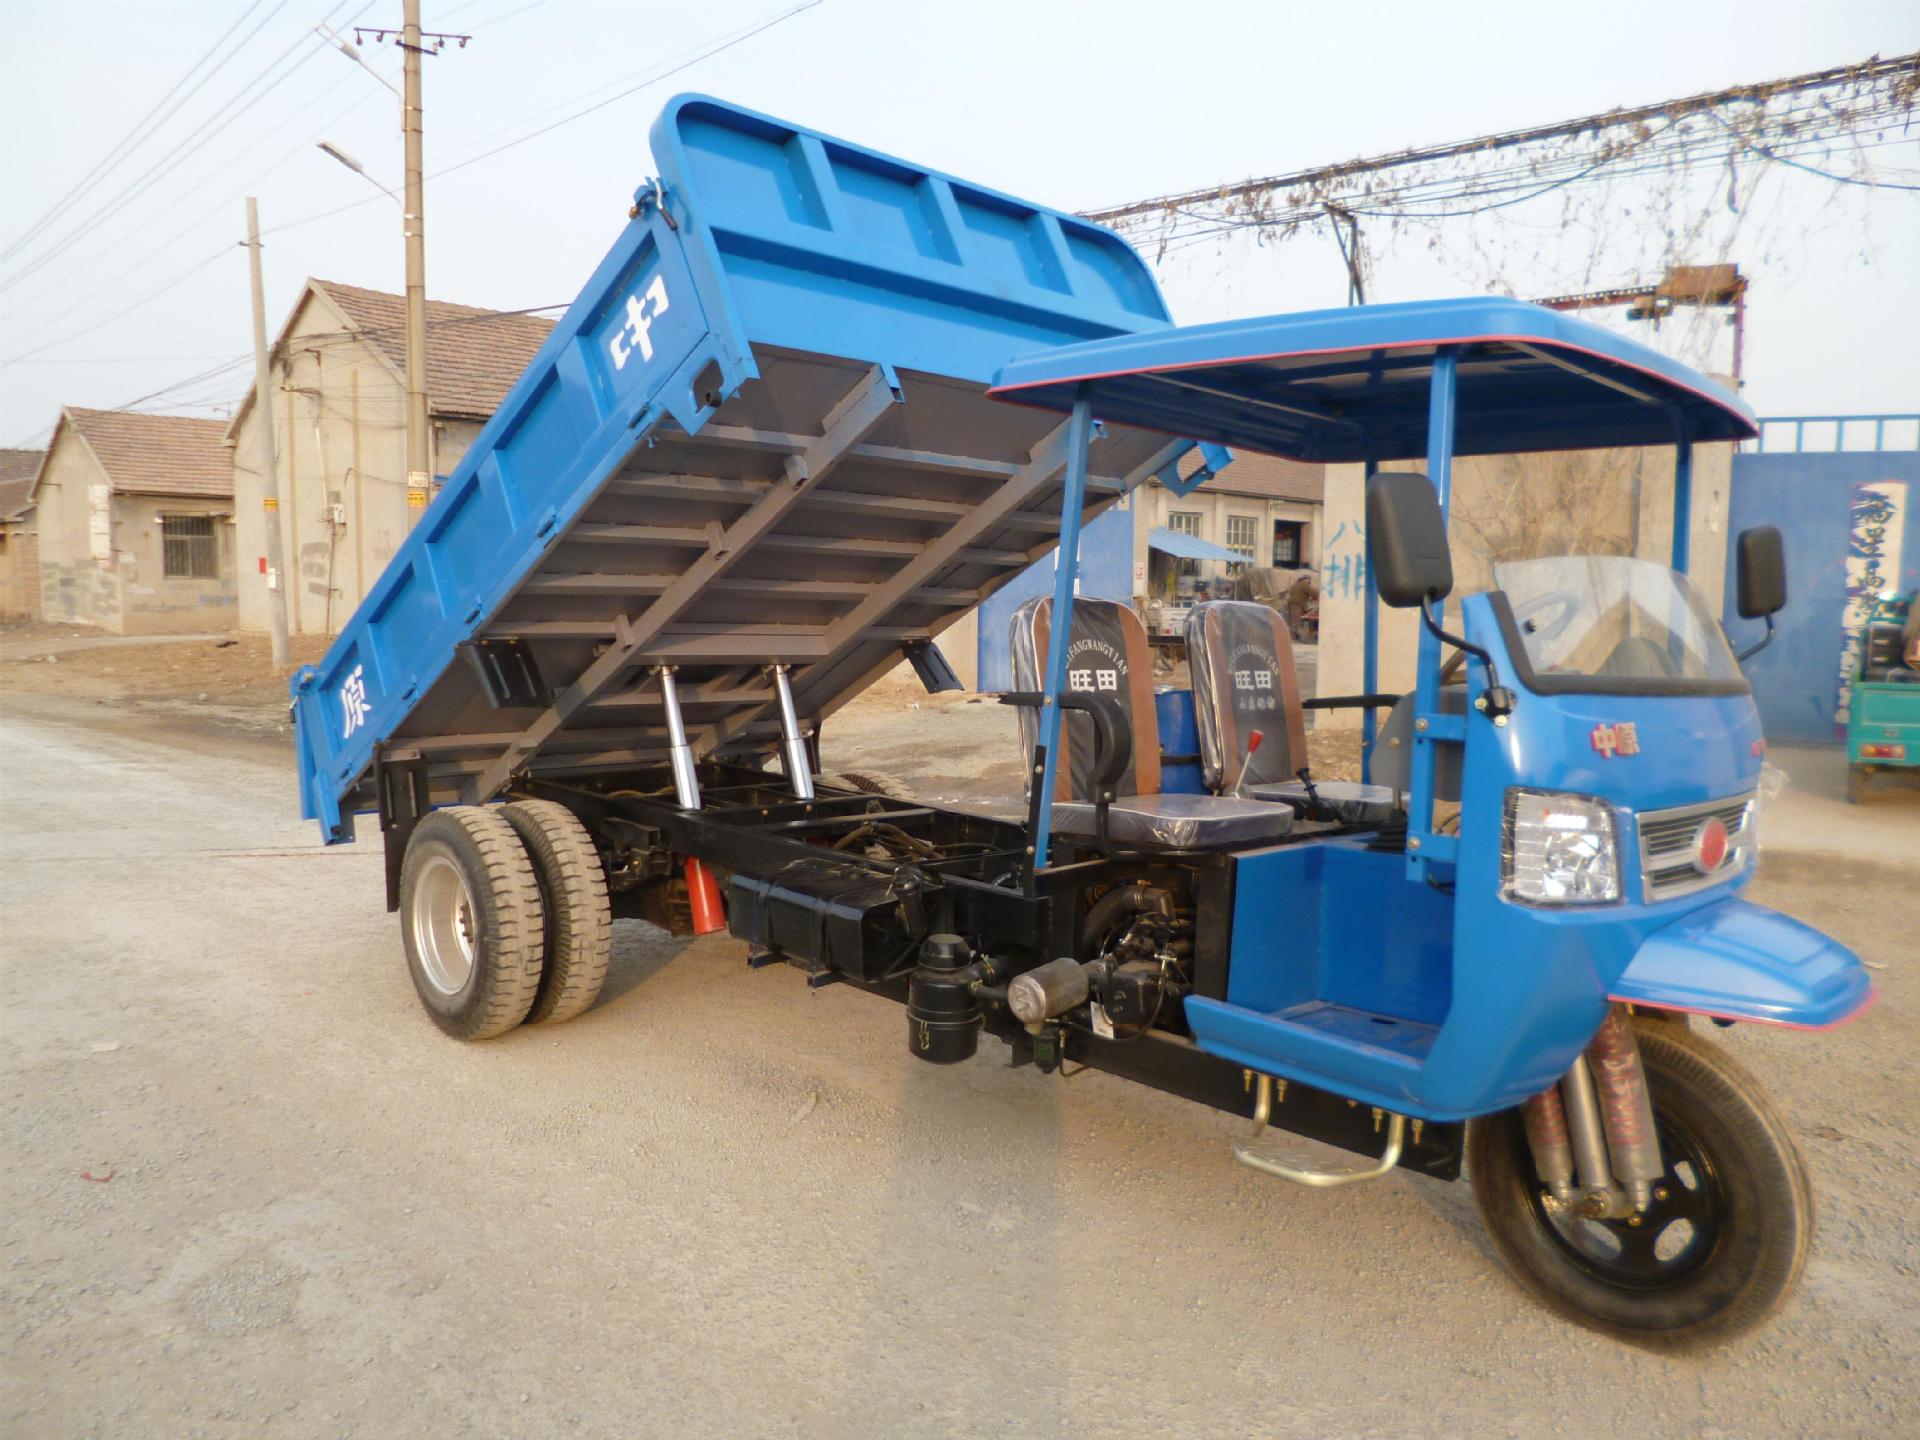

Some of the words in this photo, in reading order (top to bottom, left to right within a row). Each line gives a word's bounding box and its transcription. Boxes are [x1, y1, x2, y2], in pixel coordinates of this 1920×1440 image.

[610, 274, 669, 370] 中
[1069, 669, 1117, 693] 旺田
[1234, 670, 1272, 690] 旺田
